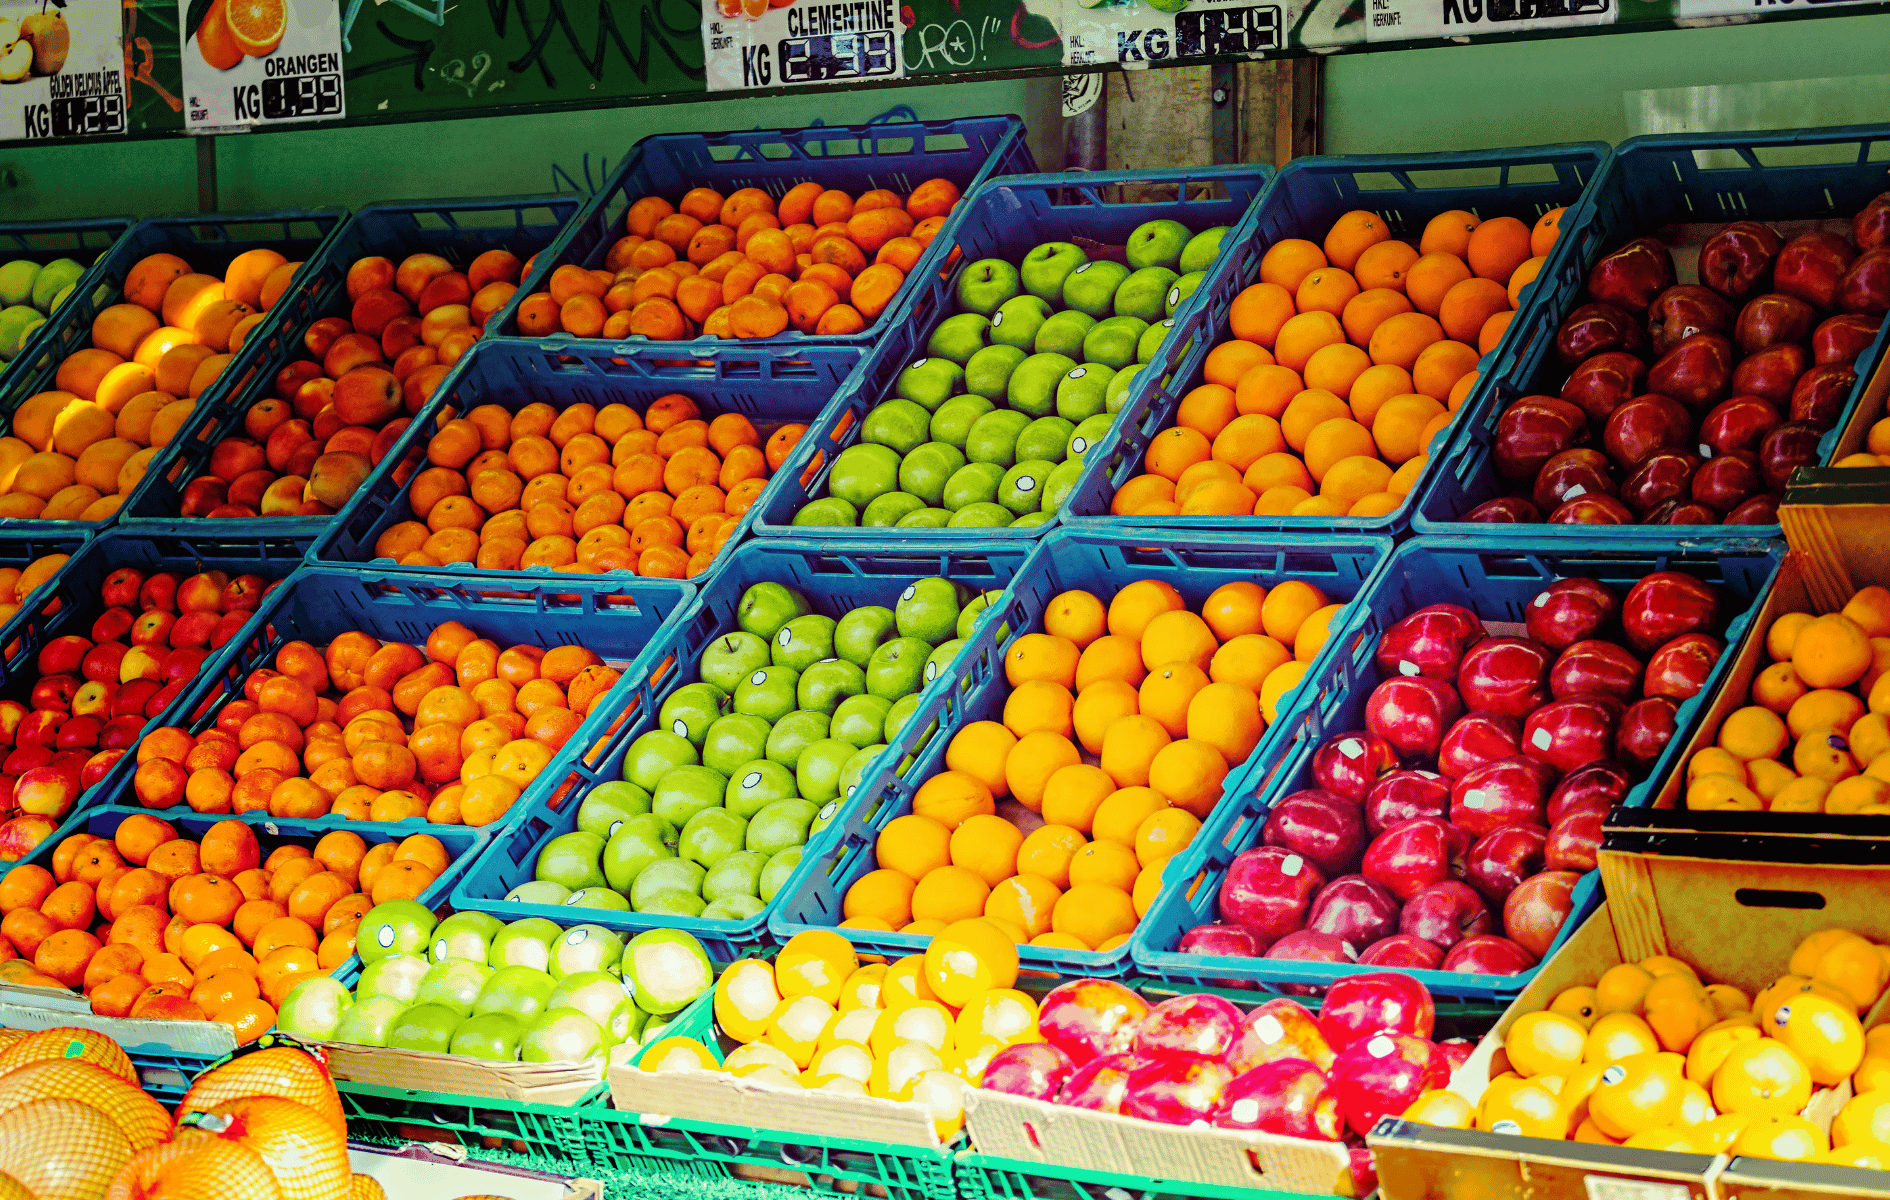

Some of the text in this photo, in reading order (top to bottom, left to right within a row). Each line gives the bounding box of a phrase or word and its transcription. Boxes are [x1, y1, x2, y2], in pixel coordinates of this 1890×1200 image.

[788, 0, 895, 37] CLEMENTINE
[1200, 5, 1278, 55] 1,49
[1373, 12, 1402, 27] HERKUNFT:
[1443, 0, 1483, 25] KG
[784, 31, 892, 80] 2,99
[1117, 28, 1170, 62] KG
[264, 52, 340, 77] ORANGEN
[742, 43, 771, 87] KG
[50, 74, 74, 99] GOLDEN
[233, 84, 261, 121] KG
[280, 75, 340, 117] 1,99
[24, 103, 50, 139] KG
[67, 95, 122, 134] 1,29
